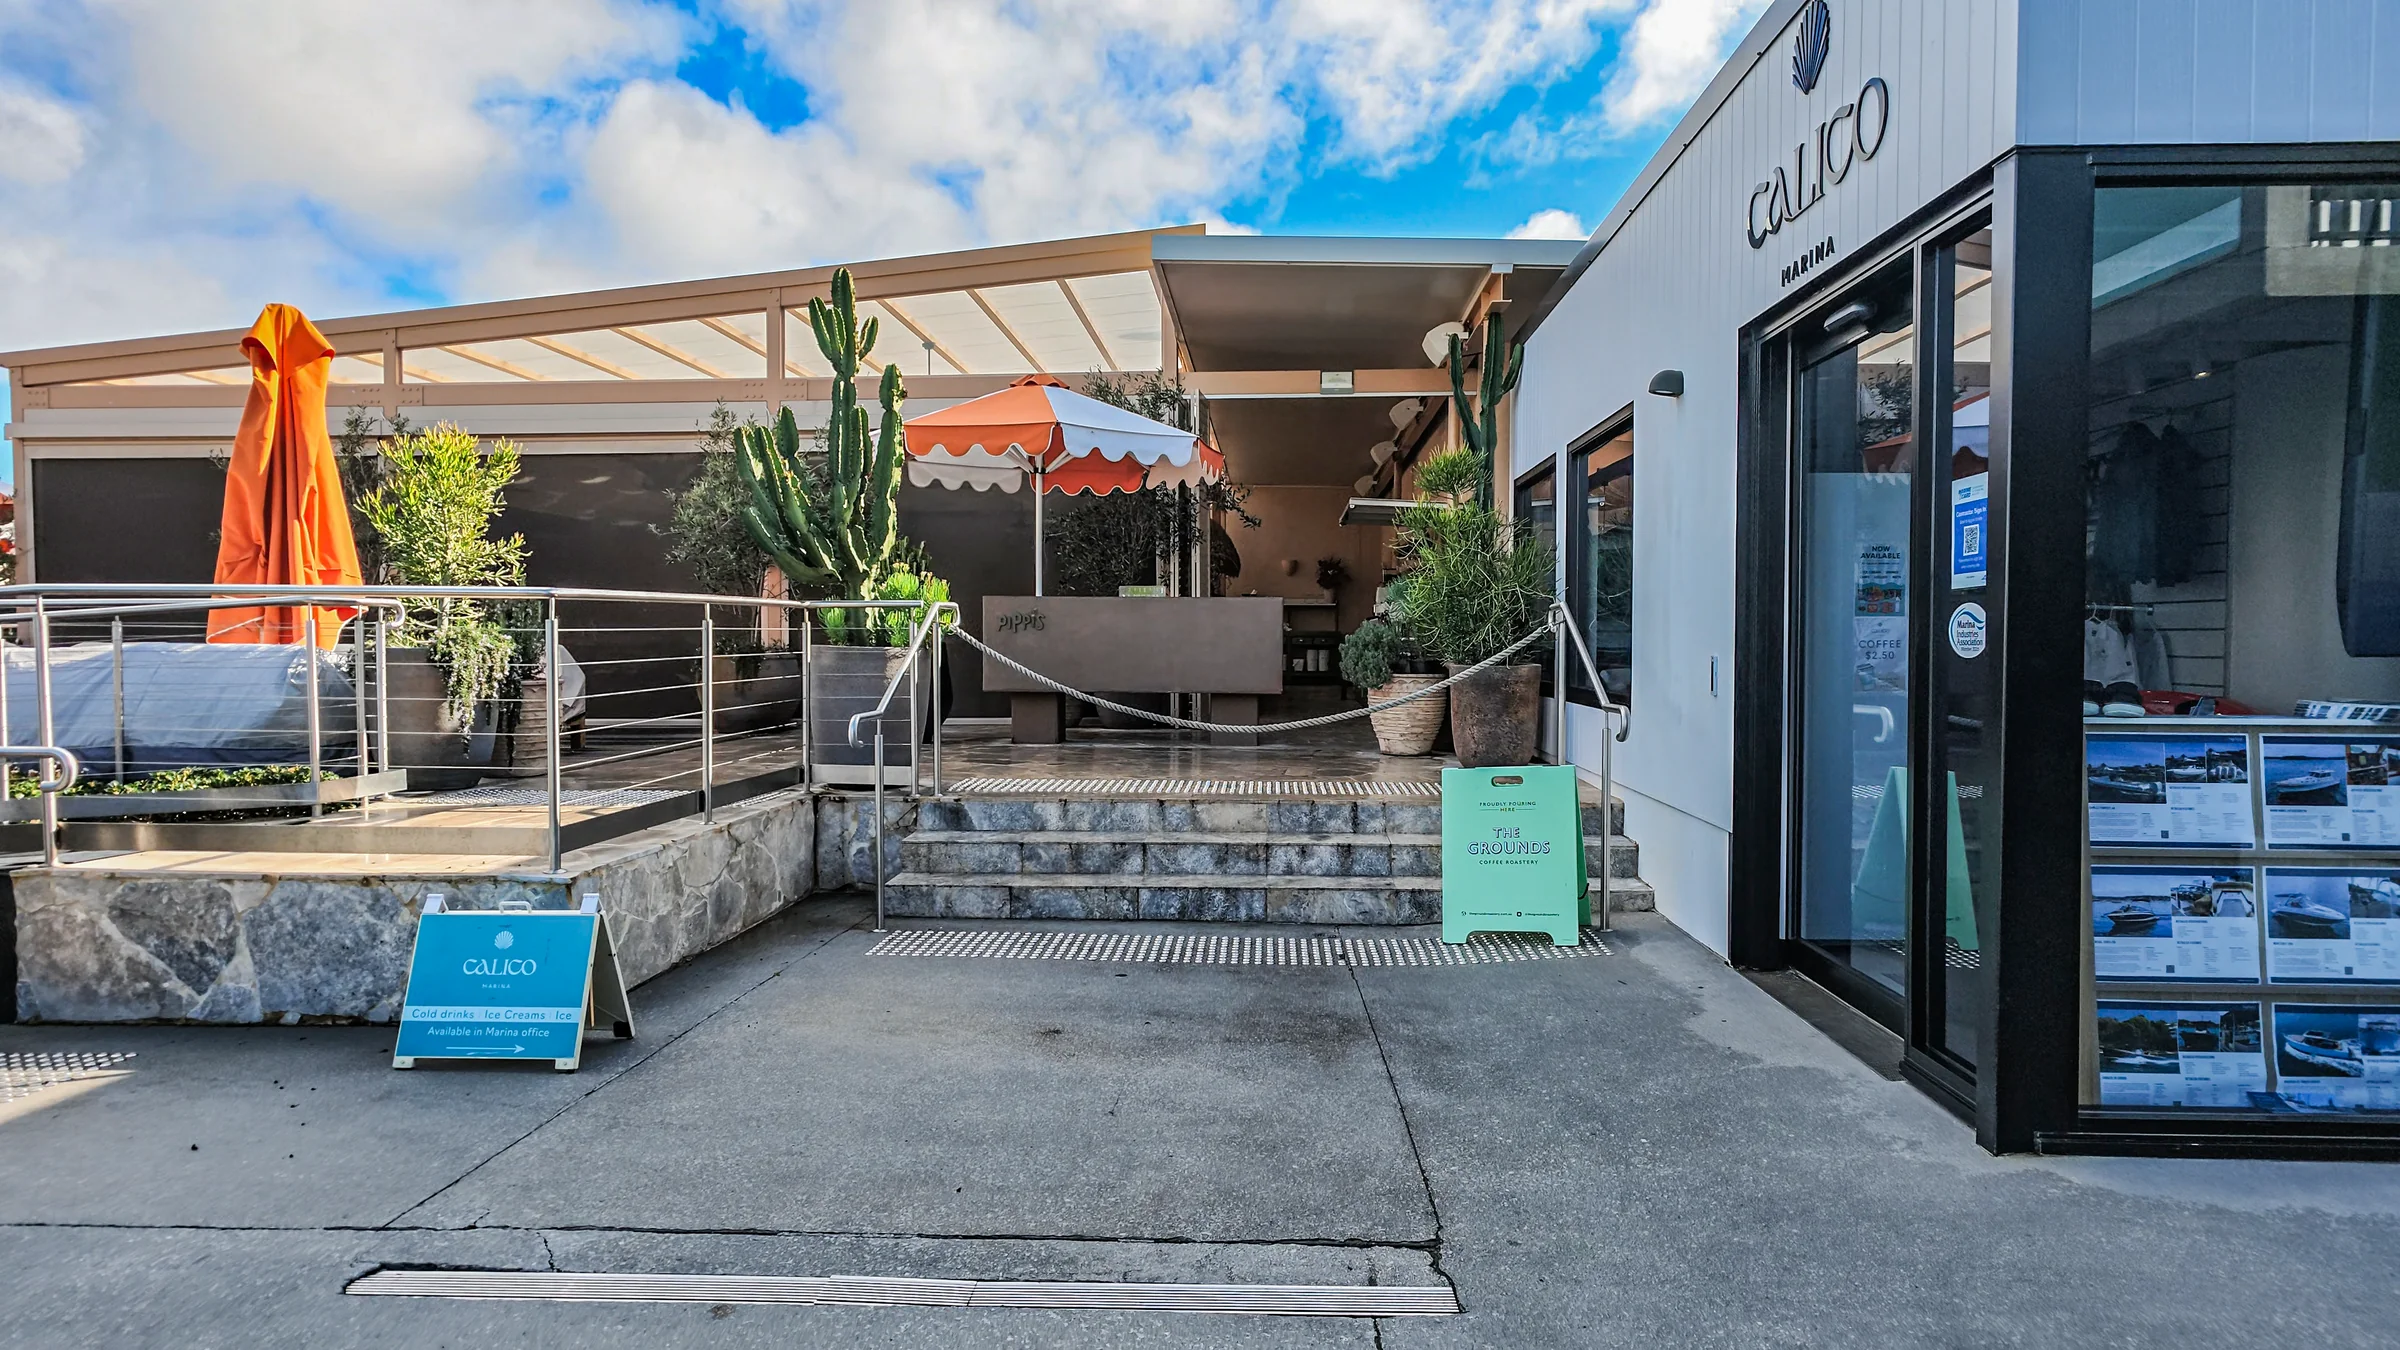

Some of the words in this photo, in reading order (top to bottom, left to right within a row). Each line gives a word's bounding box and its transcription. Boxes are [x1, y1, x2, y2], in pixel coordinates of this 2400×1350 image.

[1747, 76, 1890, 250] CALICO
[1781, 235, 1836, 288] MARINA
[1957, 620, 1976, 629] Marina
[1956, 630, 1979, 638] Industries
[1858, 639, 1901, 649] COFFEE
[1956, 638, 1983, 646] Association
[1865, 651, 1895, 660] $2.50
[1493, 827, 1520, 839] THE
[1467, 841, 1551, 855] GROUNDS
[462, 958, 537, 976] CALICO
[412, 1009, 438, 1019] Cold
[440, 1009, 475, 1019] drinks
[484, 1010, 501, 1019] Ice
[504, 1010, 546, 1020] Creams
[555, 1011, 572, 1021] Ice
[427, 1026, 471, 1037] Available
[473, 1027, 482, 1036] in
[485, 1027, 519, 1037] Marina
[521, 1027, 550, 1038] office
